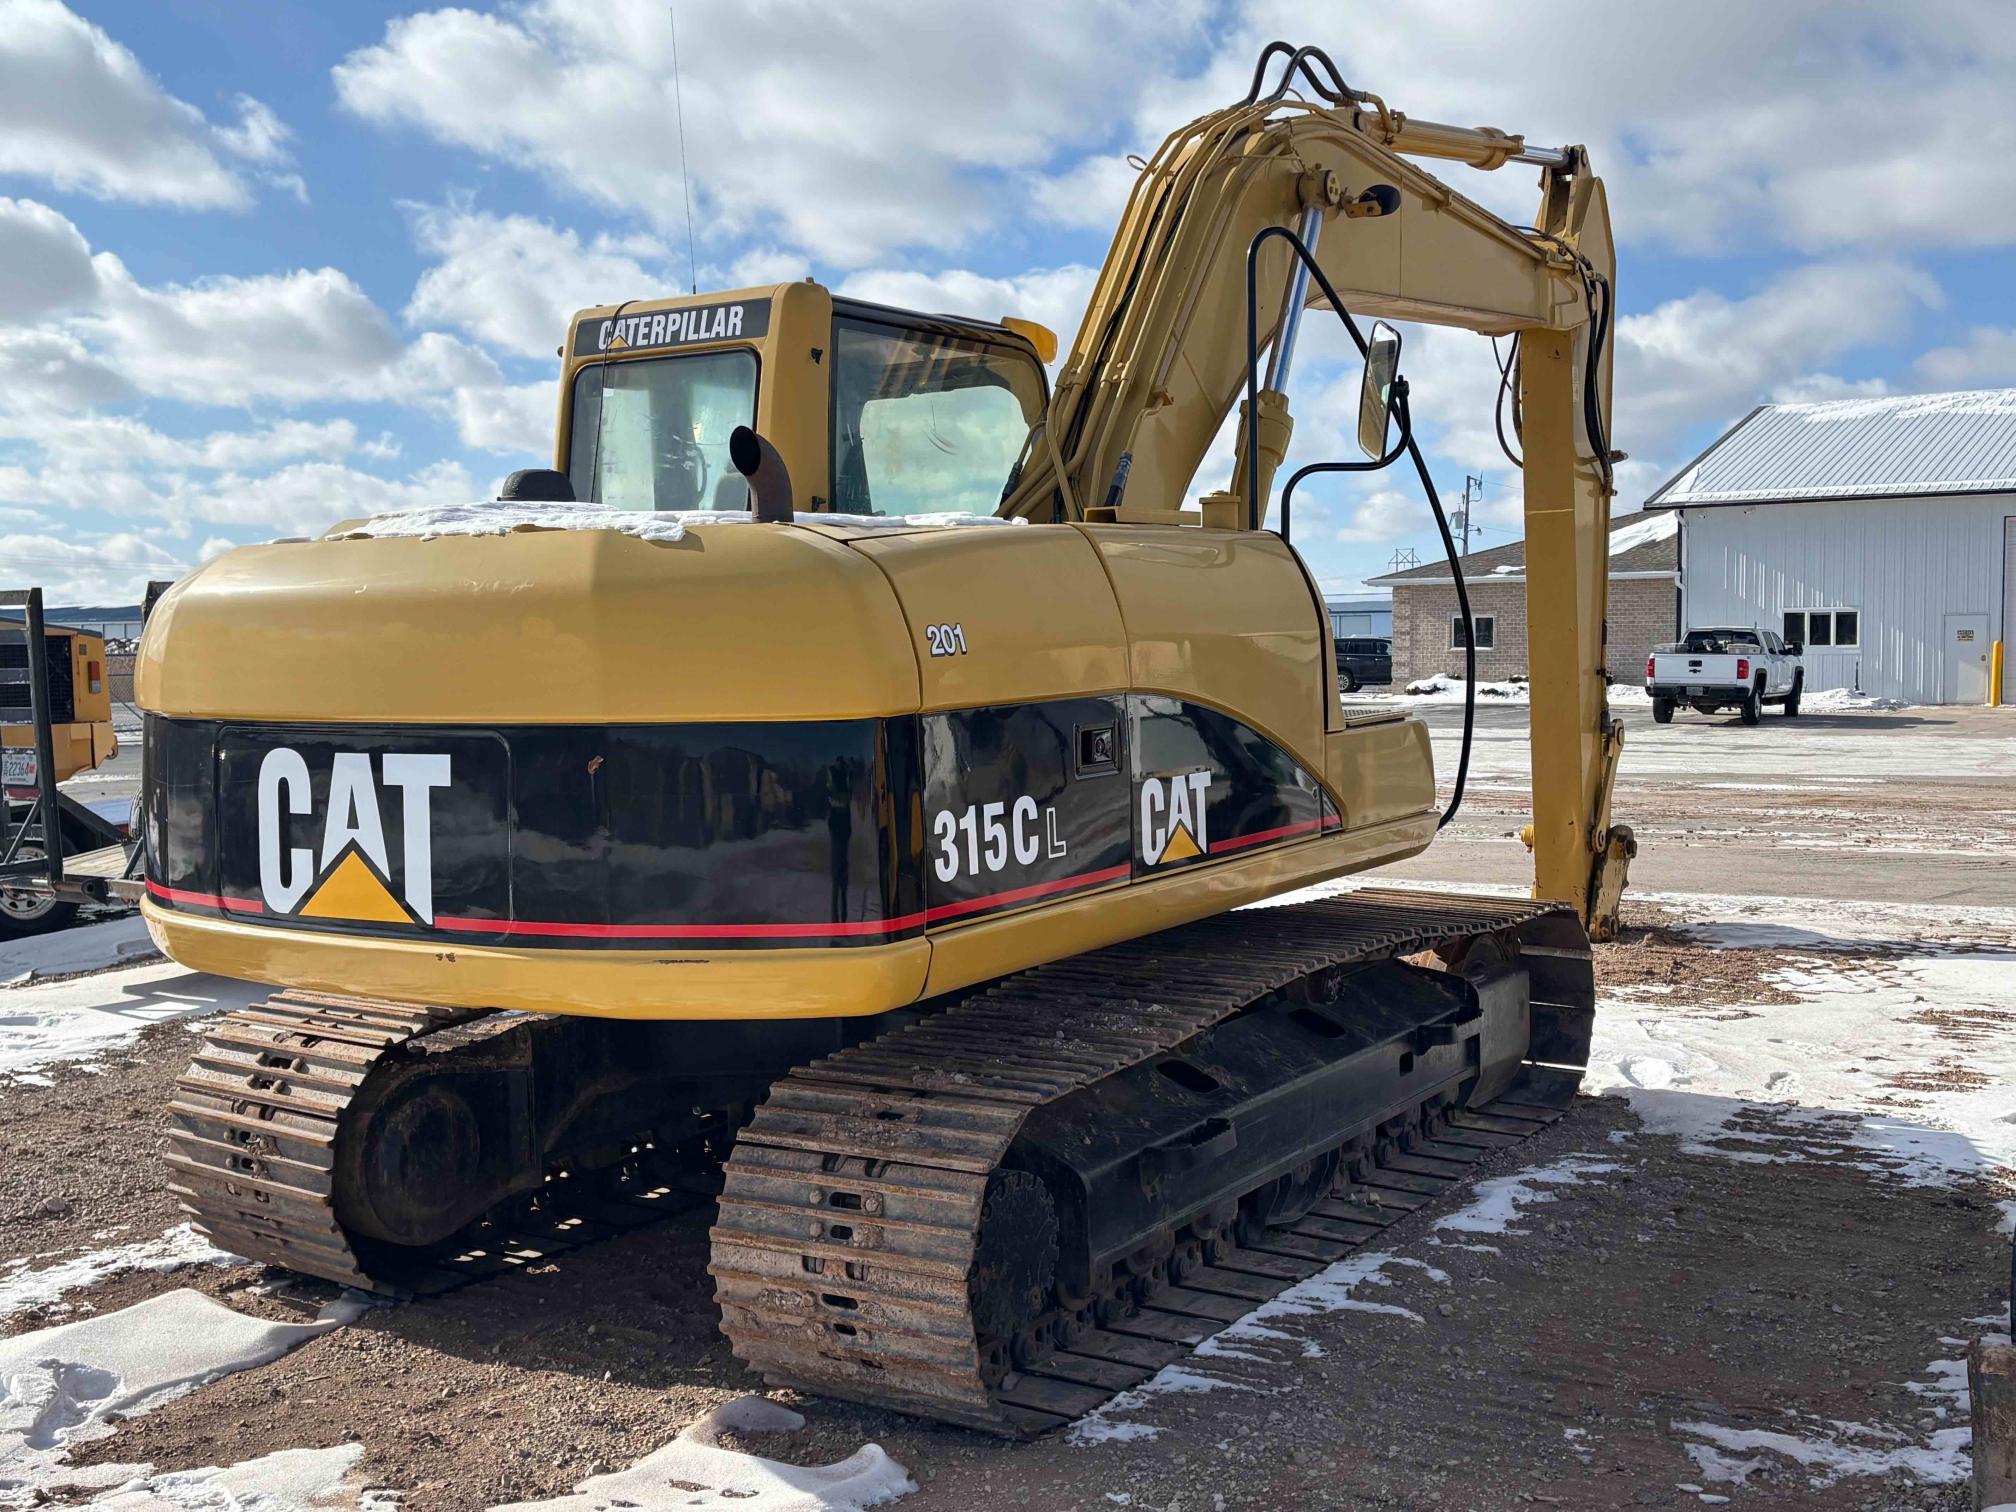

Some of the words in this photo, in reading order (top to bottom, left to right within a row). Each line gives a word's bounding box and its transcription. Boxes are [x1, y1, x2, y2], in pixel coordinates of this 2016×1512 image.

[598, 305, 744, 350] CATERPILLAR
[926, 623, 967, 657] 201
[258, 747, 451, 926] CAT
[933, 795, 1039, 883] 315C
[1141, 770, 1212, 866] CAT
